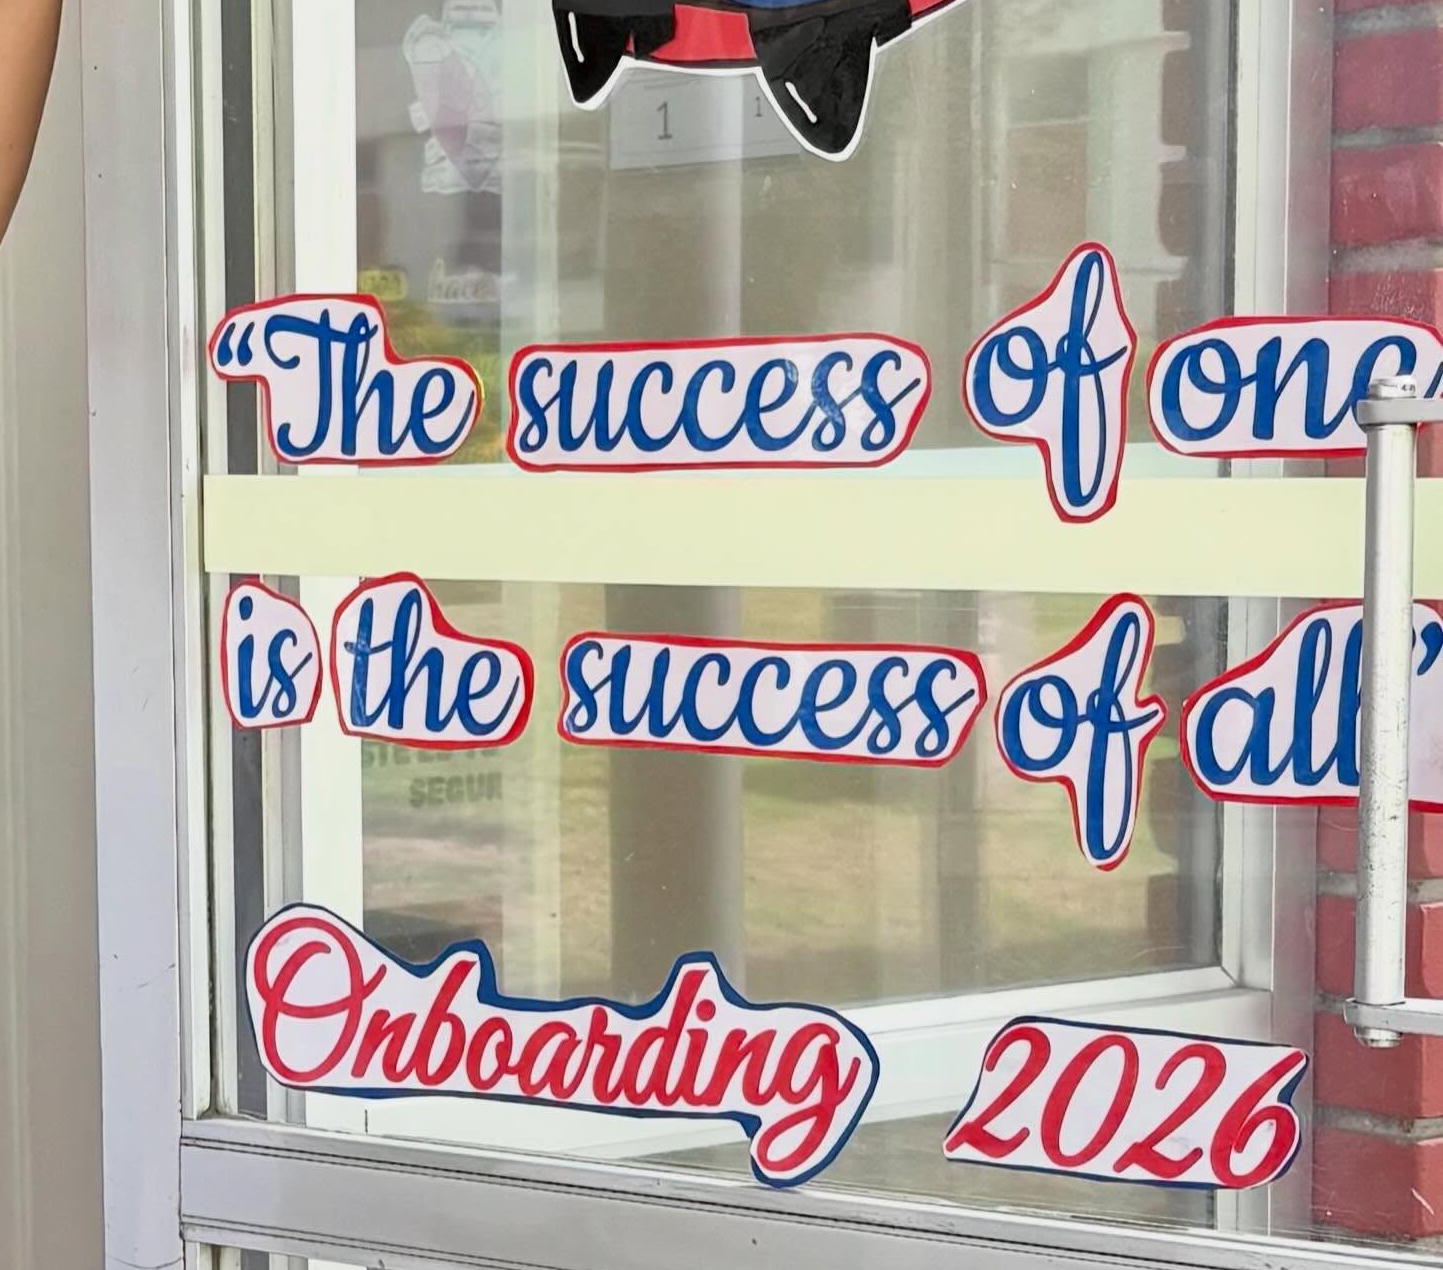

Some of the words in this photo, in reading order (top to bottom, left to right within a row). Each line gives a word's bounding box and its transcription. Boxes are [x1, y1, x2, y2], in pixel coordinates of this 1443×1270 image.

[517, 350, 922, 454] success
[972, 253, 1127, 508] of
[237, 597, 313, 719] is
[343, 588, 521, 736] the
[566, 642, 979, 757] success
[1001, 611, 1159, 861] of
[253, 918, 860, 1172] Onboarding
[944, 1026, 1306, 1189] 2026
